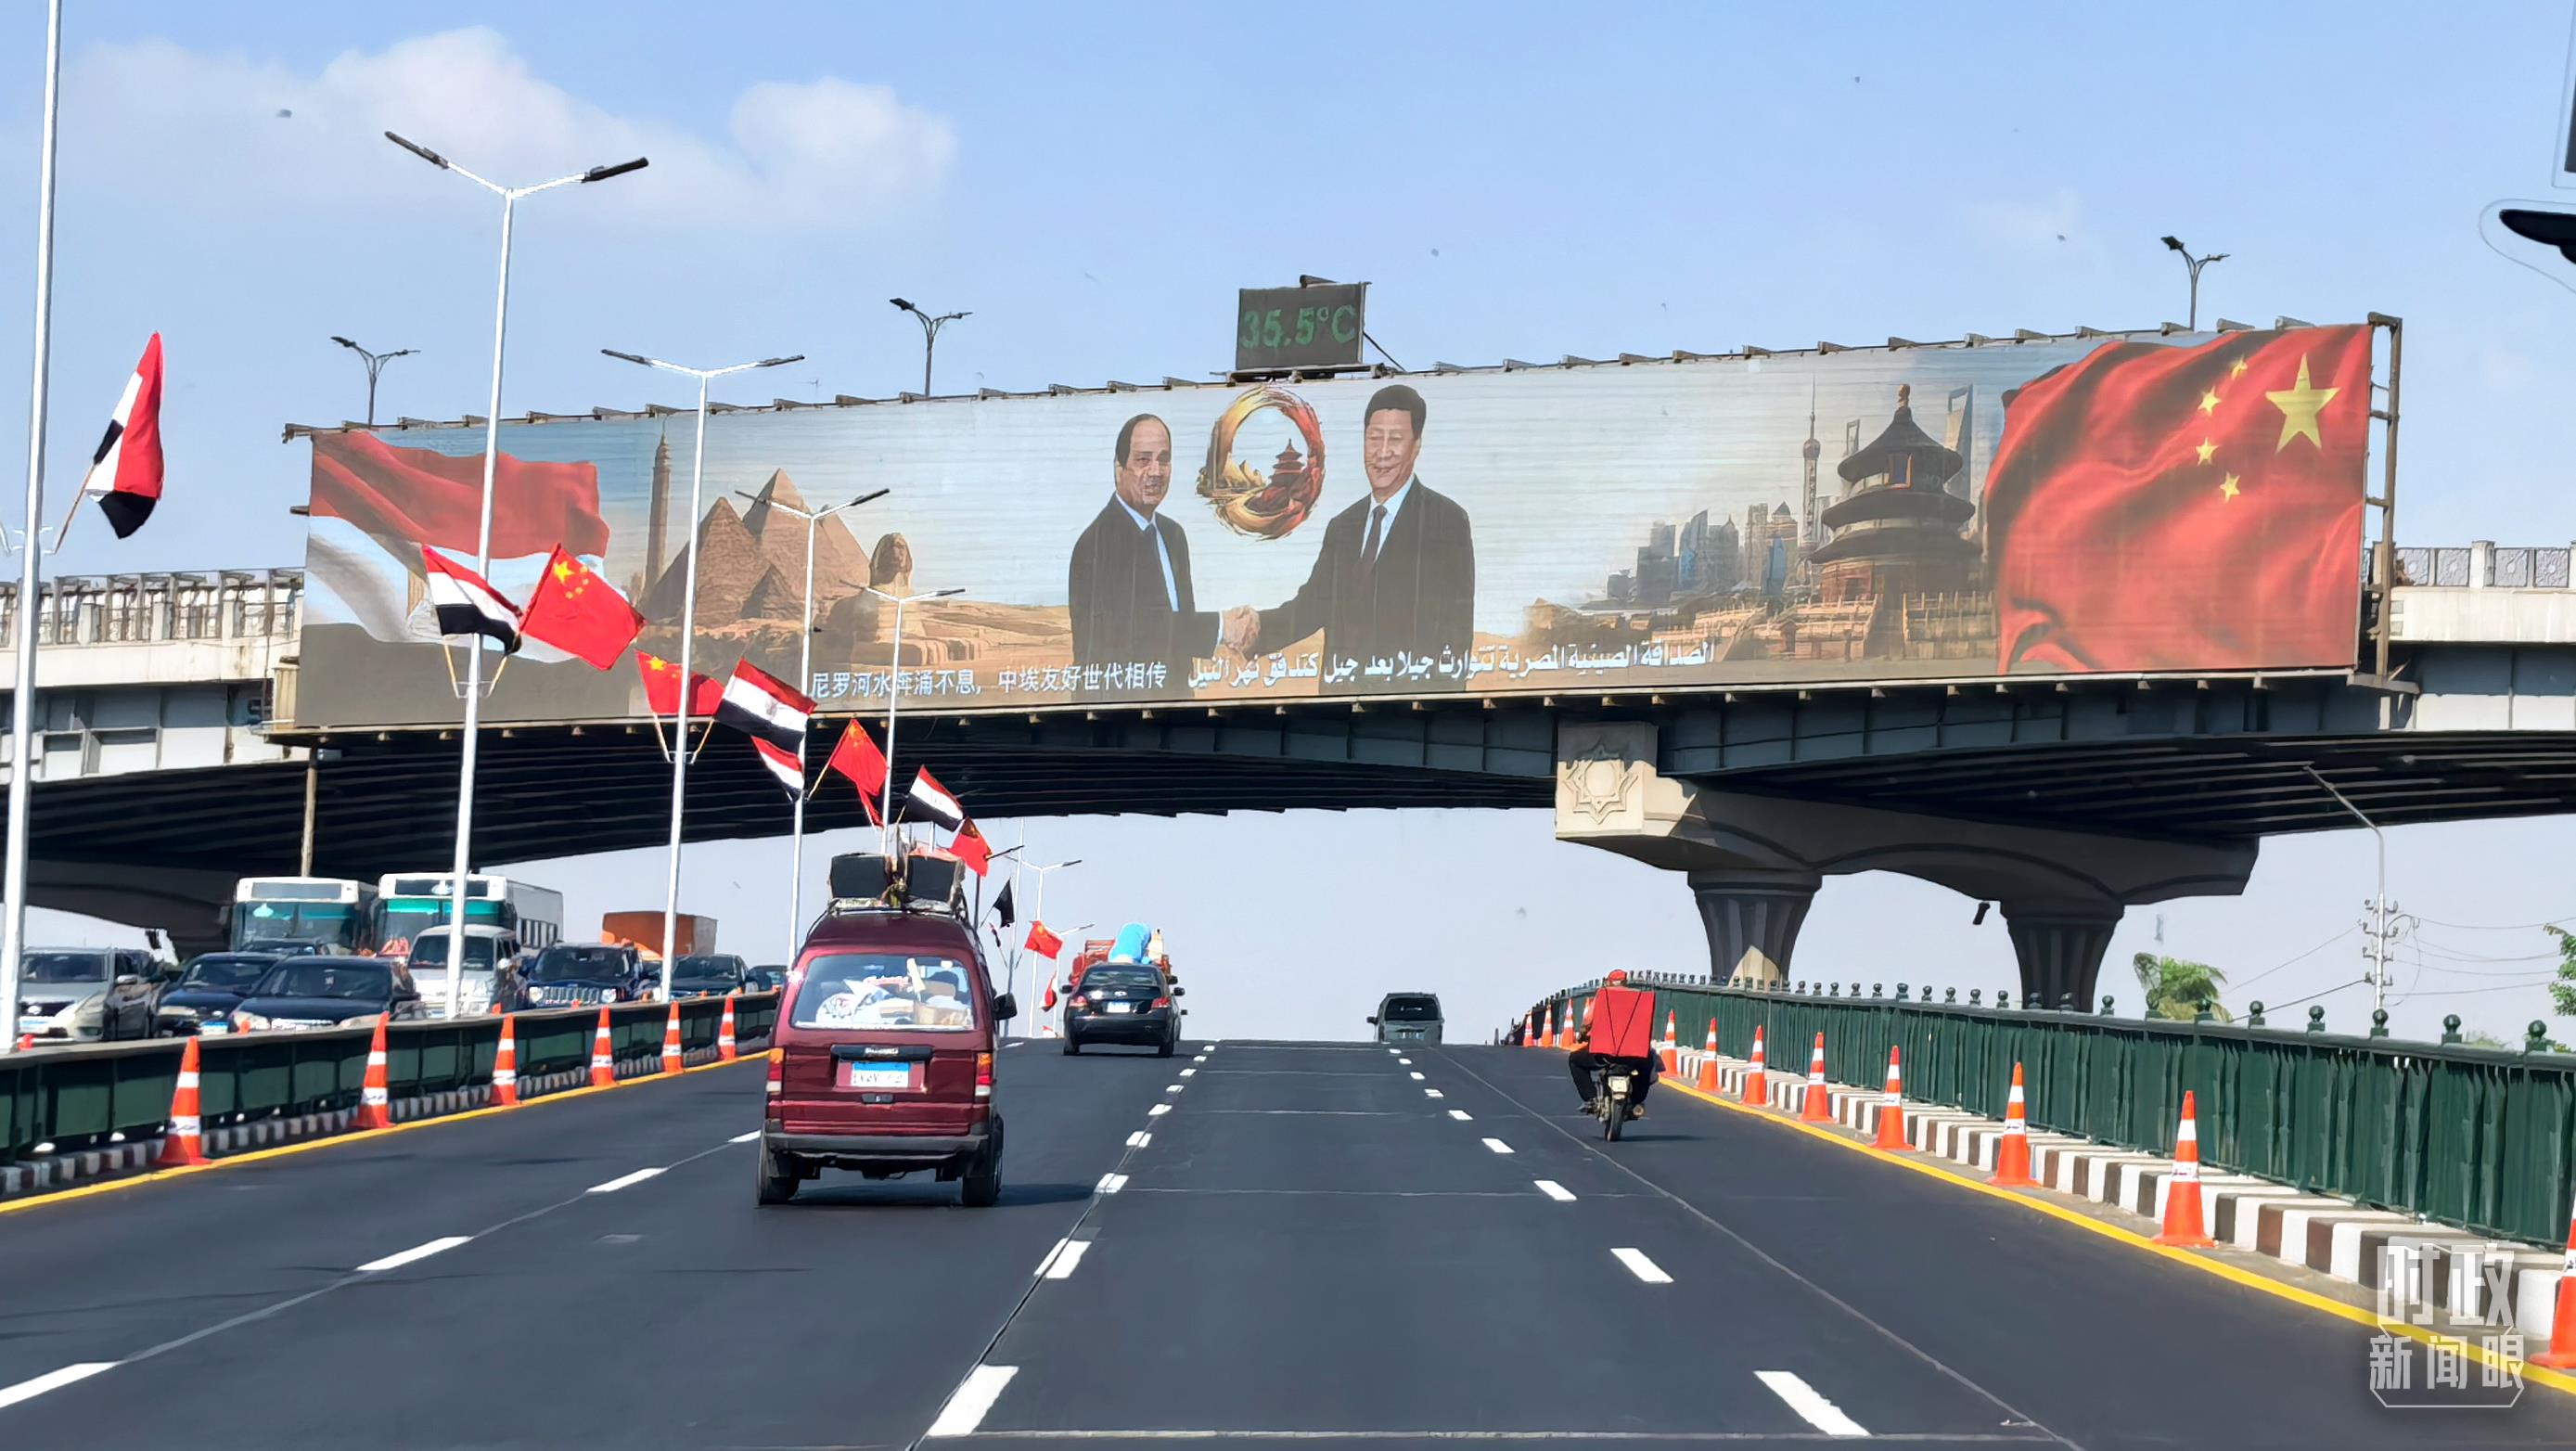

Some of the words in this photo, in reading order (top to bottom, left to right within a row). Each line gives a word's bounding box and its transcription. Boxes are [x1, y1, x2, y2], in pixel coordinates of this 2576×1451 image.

[1262, 651, 1320, 687] كتدفق
[1324, 653, 1359, 685] جيل
[1364, 654, 1394, 683] بعد
[1438, 644, 1495, 680] تتوارث
[1498, 643, 1565, 679] المصرية
[1568, 643, 1638, 675] الصينية
[1640, 638, 1715, 667] الصداقة
[1187, 655, 1230, 688] النيل
[1229, 654, 1260, 688] نهر
